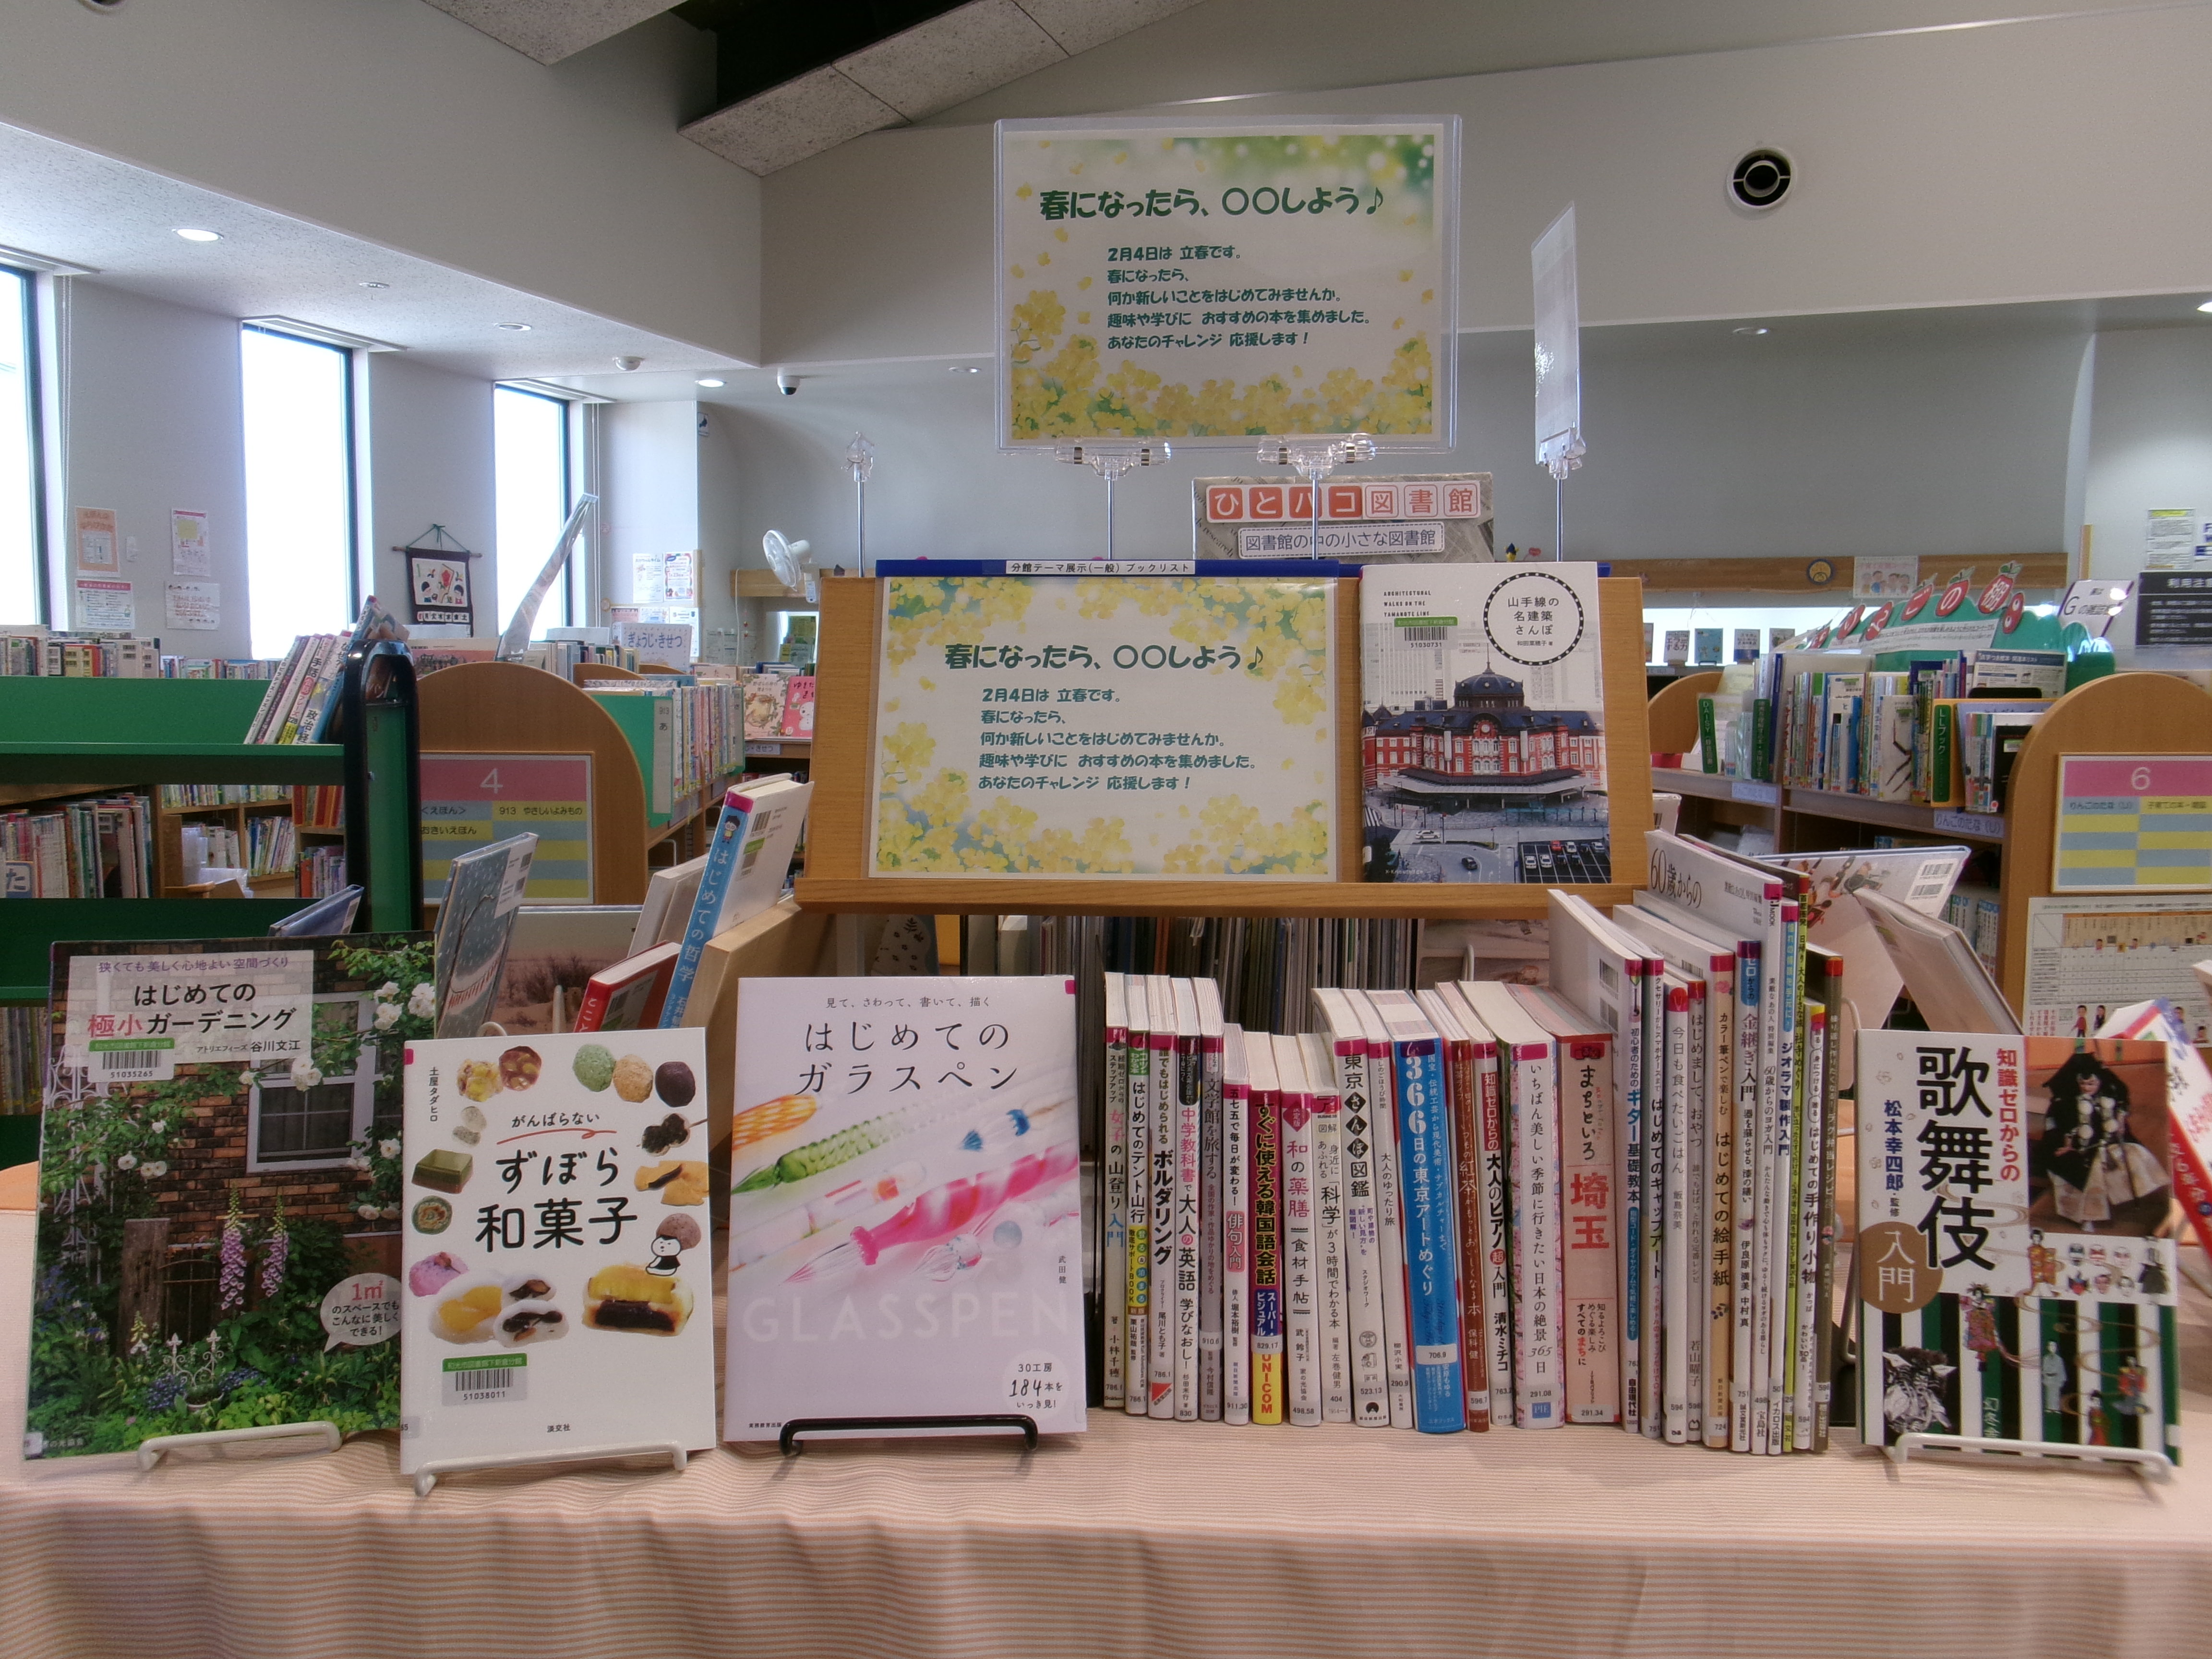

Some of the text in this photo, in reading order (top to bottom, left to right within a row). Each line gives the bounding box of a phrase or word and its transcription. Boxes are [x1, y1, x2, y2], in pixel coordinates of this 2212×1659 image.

[1107, 244, 1242, 263] 2月4日は 立春です。
[1107, 269, 1190, 284] 春になったら、
[1107, 288, 1342, 306] 何か新しいことをはじめてみませんか。
[1107, 308, 1372, 329] 趣味や学びに おすすめの本を集めました。
[1107, 334, 1223, 350] あなたのチャレンジ
[1245, 528, 1436, 552] 図書館の中の小さな図書館
[1125, 561, 1190, 574] ブックリスト
[1508, 596, 1559, 608] 山手線の
[1514, 611, 1553, 622] 名建築
[1515, 624, 1553, 636] さんぽ
[982, 687, 1122, 703] 2月4日は 立春です。
[981, 709, 1067, 725] 春になったら、
[980, 730, 1225, 747] 何か新しいことをはじめてみませんか。
[480, 768, 504, 794] 4
[979, 753, 1258, 770] 趣味や学びに おすすめの本を集めました。
[2130, 767, 2151, 791] 6
[978, 775, 1099, 791] あなたのチャレンジ
[499, 807, 583, 816] 913 やさしいよみもの
[6, 868, 26, 890] た
[678, 849, 728, 982] はじめての哲学
[134, 983, 256, 1007] はじめての
[88, 1008, 297, 1039] 極小ガーデニング
[805, 1022, 1009, 1052] はじめての
[250, 1039, 301, 1054] 谷川文江
[1741, 1013, 1758, 1103] 金継ぎ入門
[110, 1070, 154, 1079] 51035265
[795, 1061, 1018, 1095] ガラスペン
[1109, 1055, 1117, 1103] ステップアップ
[1690, 1014, 1703, 1148] はじめまして、おやつ
[428, 1067, 439, 1122] 土屋タダヒロ
[1484, 1074, 1499, 1150] 知識ゼロからの
[1672, 1027, 1685, 1173] 今日も食べたいごはん
[511, 1112, 600, 1129] がんばらない
[1203, 1078, 1220, 1180] 文学館を旅する
[1344, 1054, 1370, 1198] 東京さんぽ図鑑
[1996, 1048, 2020, 1182] 知識ゼロからの
[1130, 1082, 1145, 1224] はじめてのテント山行
[1318, 1141, 1327, 1179] あふれる
[1329, 1144, 1339, 1175] 身近に
[1627, 1091, 1641, 1202] ギター基礎教本
[1916, 1046, 1996, 1272] 歌舞伎
[495, 1147, 619, 1195] ずぼら
[1107, 1109, 1126, 1248] 女子の山登り入門
[1381, 1153, 1396, 1226] 大人のゆったり旅
[1406, 1056, 1433, 1296] 366日の東京アートめぐり
[1650, 1099, 1662, 1279] はじめてのキャップアート
[1153, 1151, 1174, 1266] ボルダリング
[1178, 1107, 1196, 1291] 中学教科書で大人の英語
[1255, 1102, 1278, 1286] すぐに使える韓国語会話
[1570, 1172, 1610, 1250] 埼玉
[1713, 1132, 1731, 1286] はじめての絵手紙
[1802, 1127, 1820, 1285] はじめての手作り小物
[475, 1196, 638, 1253] 和菓子
[1286, 1142, 1310, 1305] 和の薬膳 食材手帖
[1528, 1064, 1553, 1374] いちばん美しい季節に行きたい日本の絶景365日
[1227, 1214, 1244, 1269] 俳句入門
[1058, 1255, 1067, 1285] 武田健
[1877, 1230, 1916, 1303] 入門
[331, 1301, 399, 1315] のスペースでも
[331, 1313, 399, 1326] こんなに美しく
[742, 1293, 1068, 1343] GLASSPEN
[1587, 1303, 1597, 1352] めぐる楽しみ
[1596, 1303, 1606, 1352] 知るよろこび
[1158, 1311, 1166, 1350] 尾川とも子
[1494, 1312, 1509, 1372] 清水ミチコ
[1018, 1362, 1053, 1373] 30工房
[1261, 1353, 1273, 1414] UNICOM
[463, 1391, 506, 1401] 51038011
[1009, 1379, 1063, 1398] 184本を
